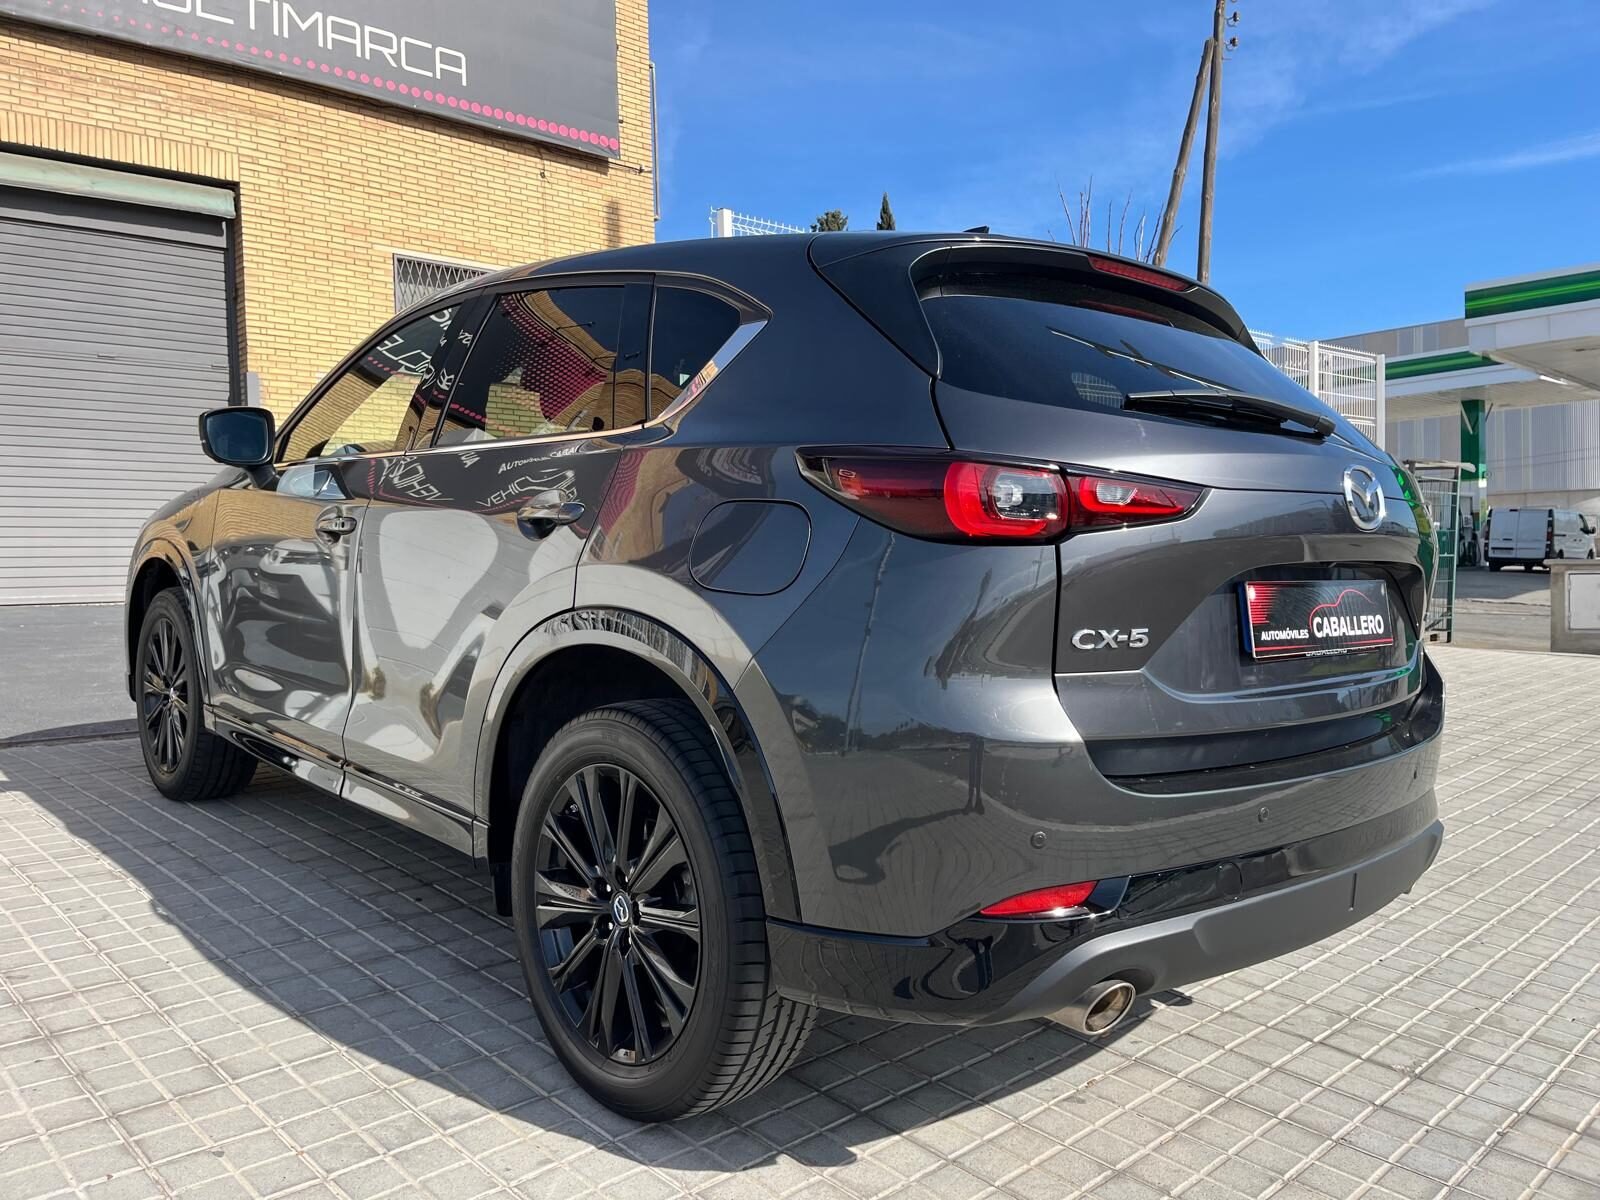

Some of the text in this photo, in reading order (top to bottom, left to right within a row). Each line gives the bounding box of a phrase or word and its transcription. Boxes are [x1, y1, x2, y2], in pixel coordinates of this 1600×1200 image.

[142, 0, 467, 87] LTIMARCA
[1071, 627, 1149, 650] CX-5
[1261, 614, 1384, 641] AUTOMÓVILES CABALLERO
